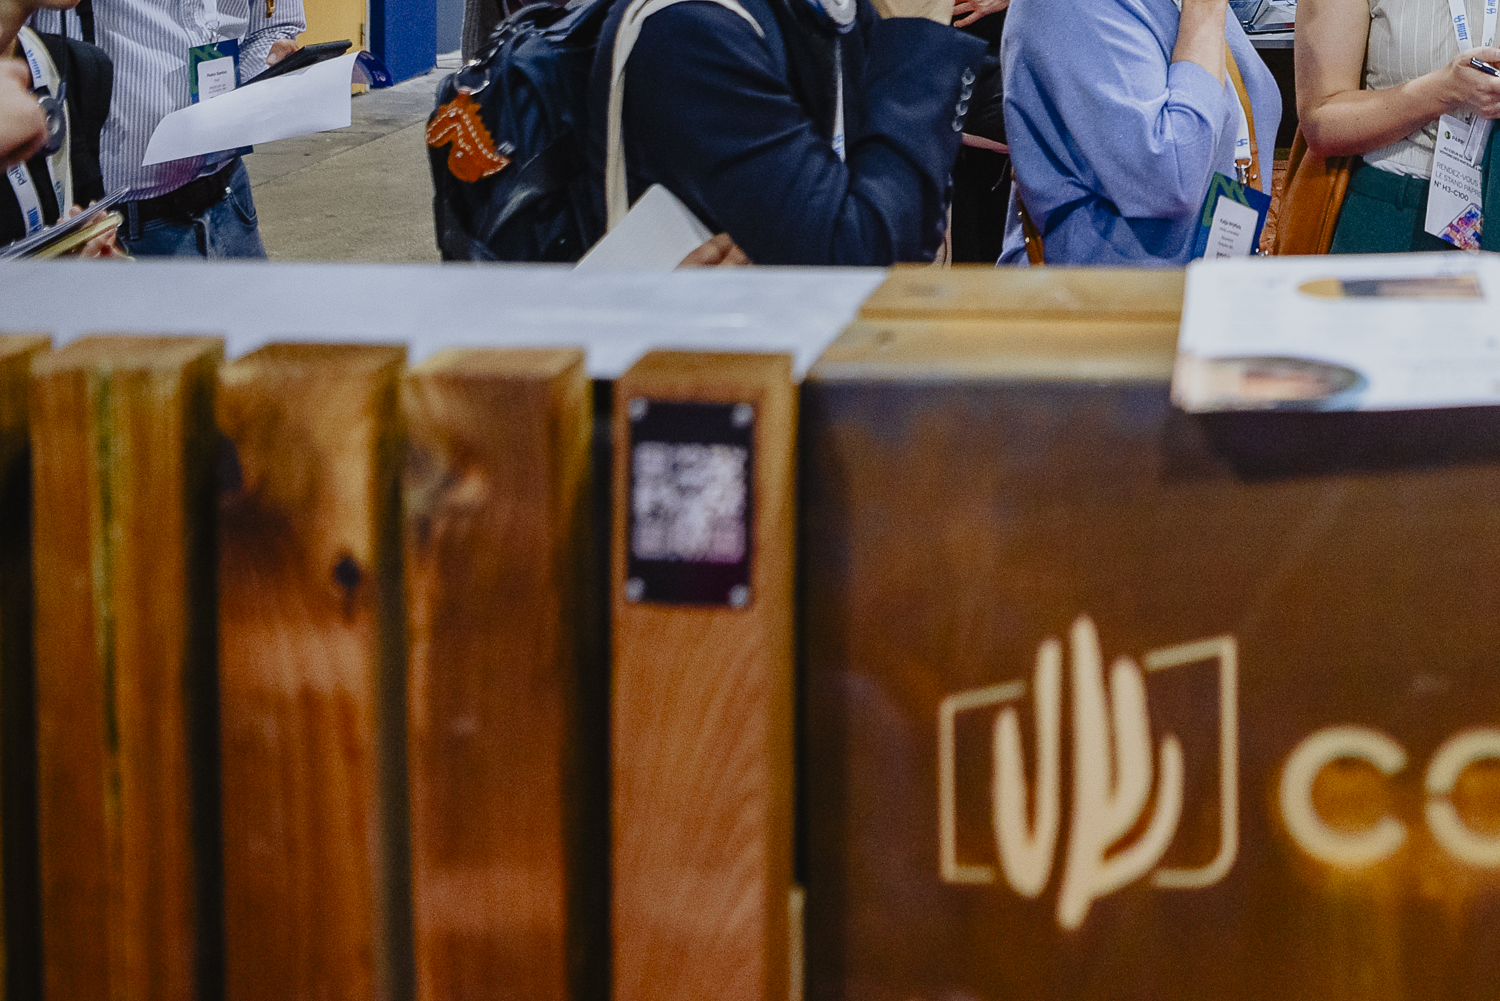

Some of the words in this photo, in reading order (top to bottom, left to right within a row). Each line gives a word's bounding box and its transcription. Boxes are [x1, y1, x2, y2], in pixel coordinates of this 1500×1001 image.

[1457, 25, 1468, 40] HUOT
[1435, 171, 1442, 180] LE
[1443, 174, 1463, 188] STAND
[1437, 162, 1478, 187] RENDEZ-VOUS
[1442, 185, 1469, 201] H3-C100
